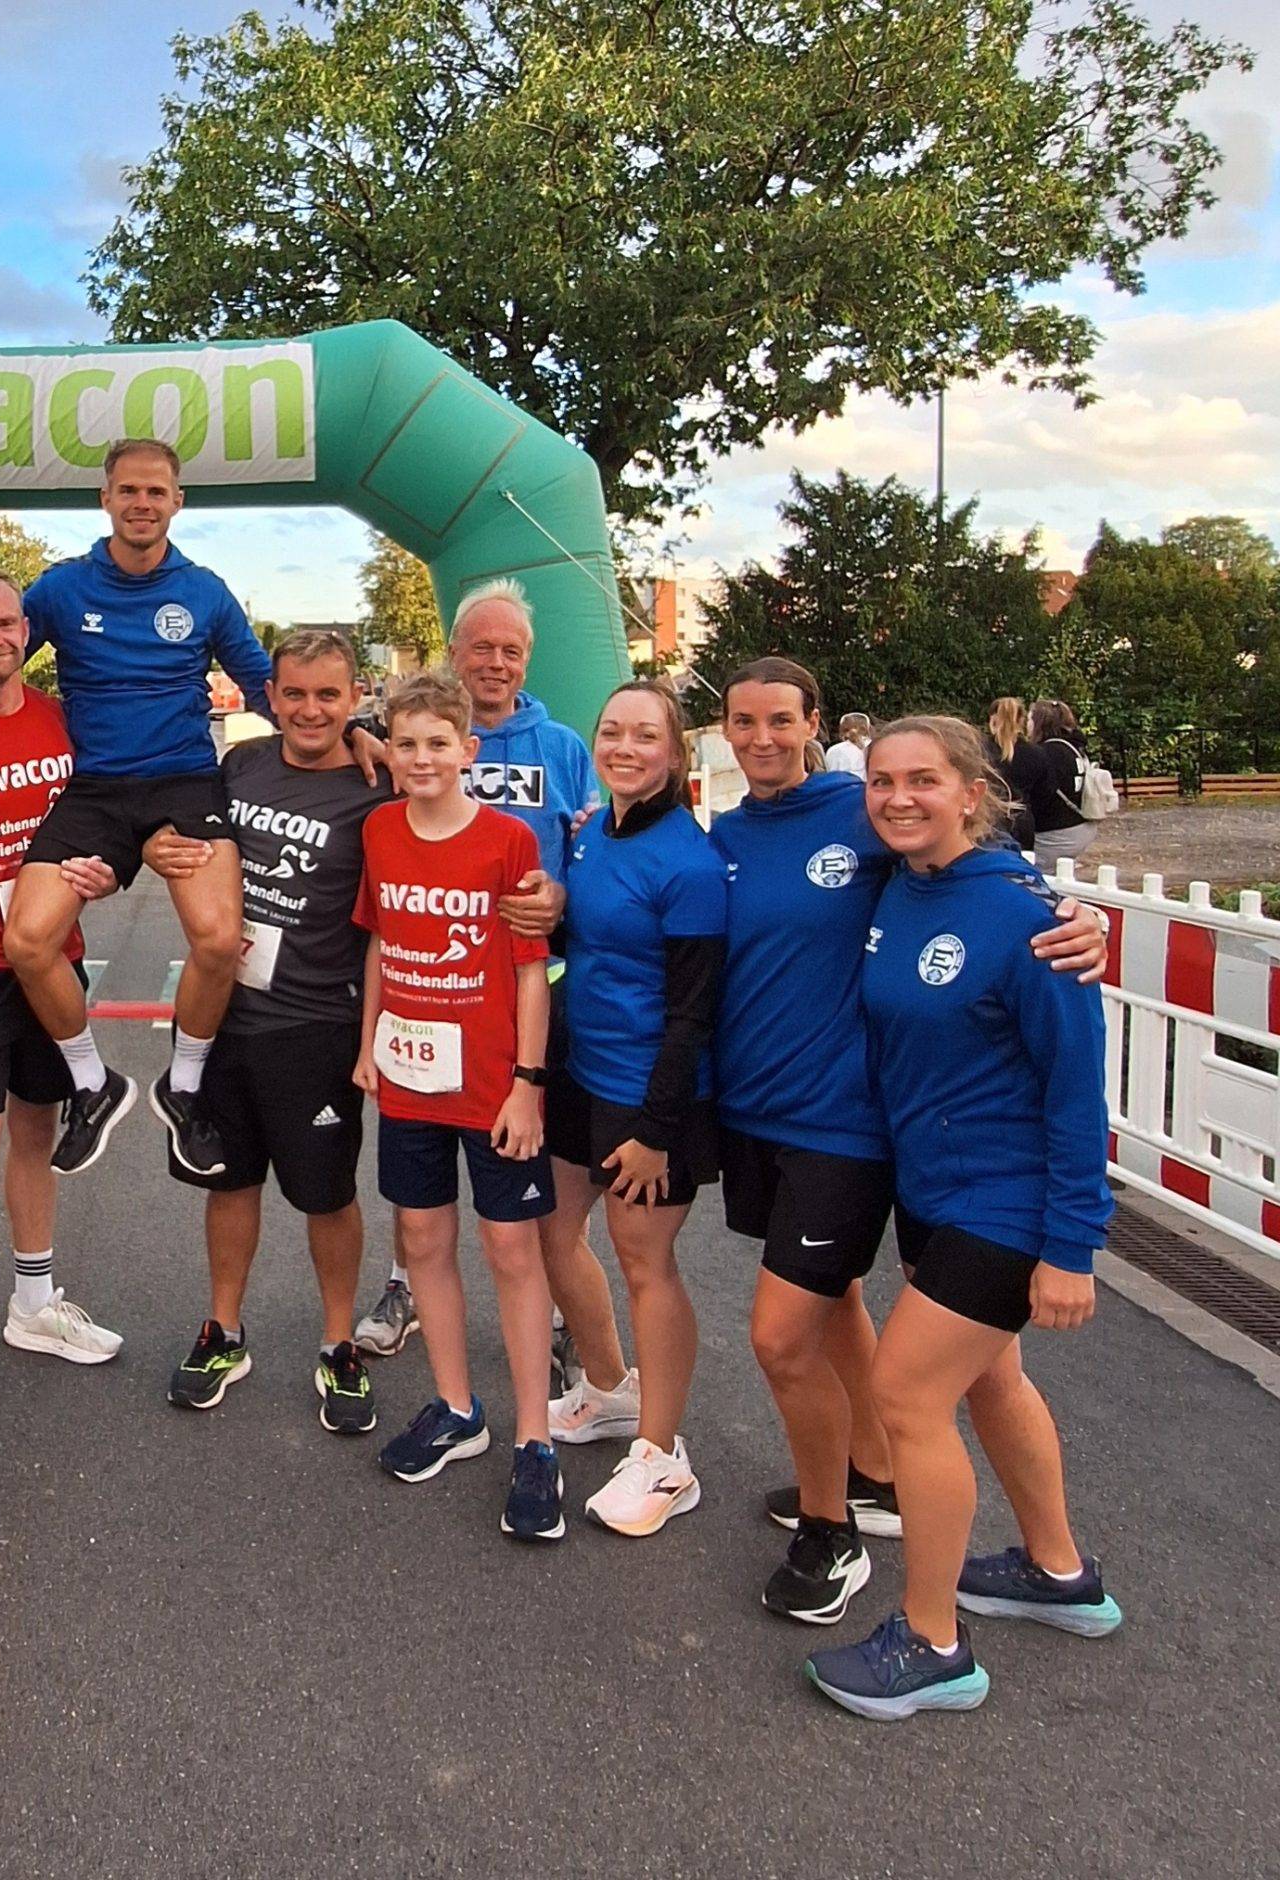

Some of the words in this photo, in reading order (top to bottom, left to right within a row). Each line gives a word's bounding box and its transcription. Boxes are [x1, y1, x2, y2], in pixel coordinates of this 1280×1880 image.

[228, 799, 331, 848] avacon
[380, 881, 490, 917] avacon
[380, 940, 438, 964] Rethener
[381, 962, 485, 989] Feierabendlauf
[388, 1036, 435, 1062] 418
